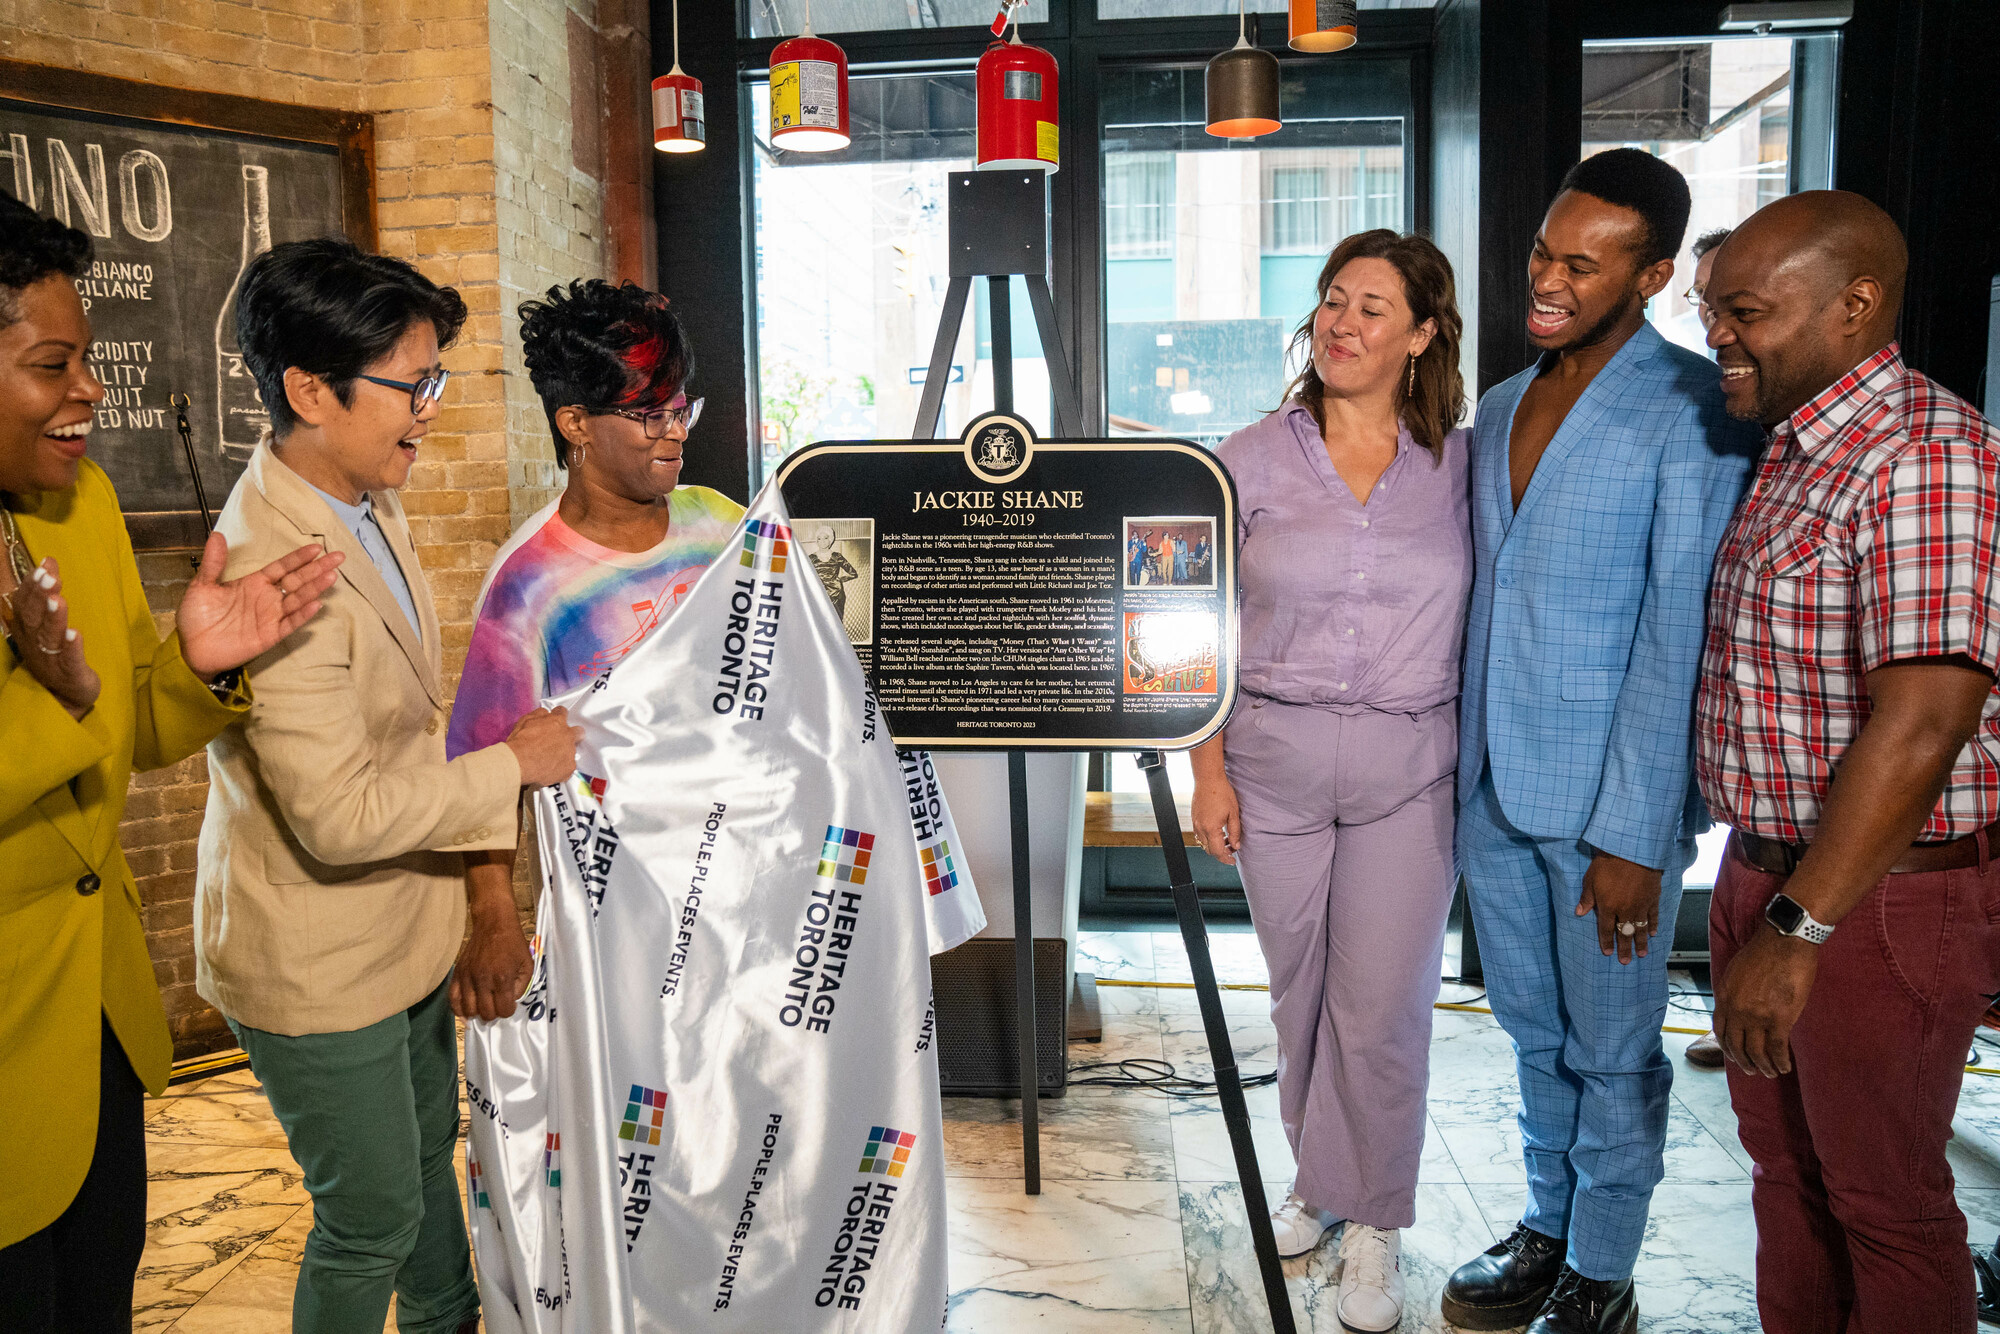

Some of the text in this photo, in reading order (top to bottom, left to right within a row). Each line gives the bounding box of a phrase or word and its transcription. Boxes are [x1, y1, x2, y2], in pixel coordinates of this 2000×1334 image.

[84, 261, 153, 283] BIANCO
[88, 341, 152, 362] CIDITY
[93, 408, 166, 429] ED NUT
[912, 491, 1084, 513] JACKIE SHANE
[882, 533, 900, 542] Jackie
[973, 533, 1009, 542] transgender
[882, 541, 913, 550] nightclubs
[980, 541, 1016, 550] high-energy
[1083, 556, 1103, 565] joined
[882, 573, 896, 582] body
[910, 573, 928, 582] began
[936, 573, 959, 582] identify
[1018, 573, 1037, 582] family
[1095, 573, 1115, 582] played
[891, 582, 922, 590] recordings
[982, 582, 1013, 590] performed
[1087, 582, 1097, 590] Joe
[959, 605, 979, 614] played
[1049, 605, 1071, 614] Motley
[978, 614, 1000, 622] packed
[1002, 614, 1034, 622] nightclubs
[1088, 614, 1115, 622] dynamic
[712, 578, 756, 715] TORONTO
[740, 581, 784, 721] HERITAGE
[974, 678, 999, 687] Angeles
[779, 888, 836, 1028] TORONTO
[806, 891, 862, 1034] HERITAGE
[622, 1153, 656, 1253] HERIT
[815, 1181, 872, 1308] TORONTO
[837, 1182, 898, 1311] HERITAGE
